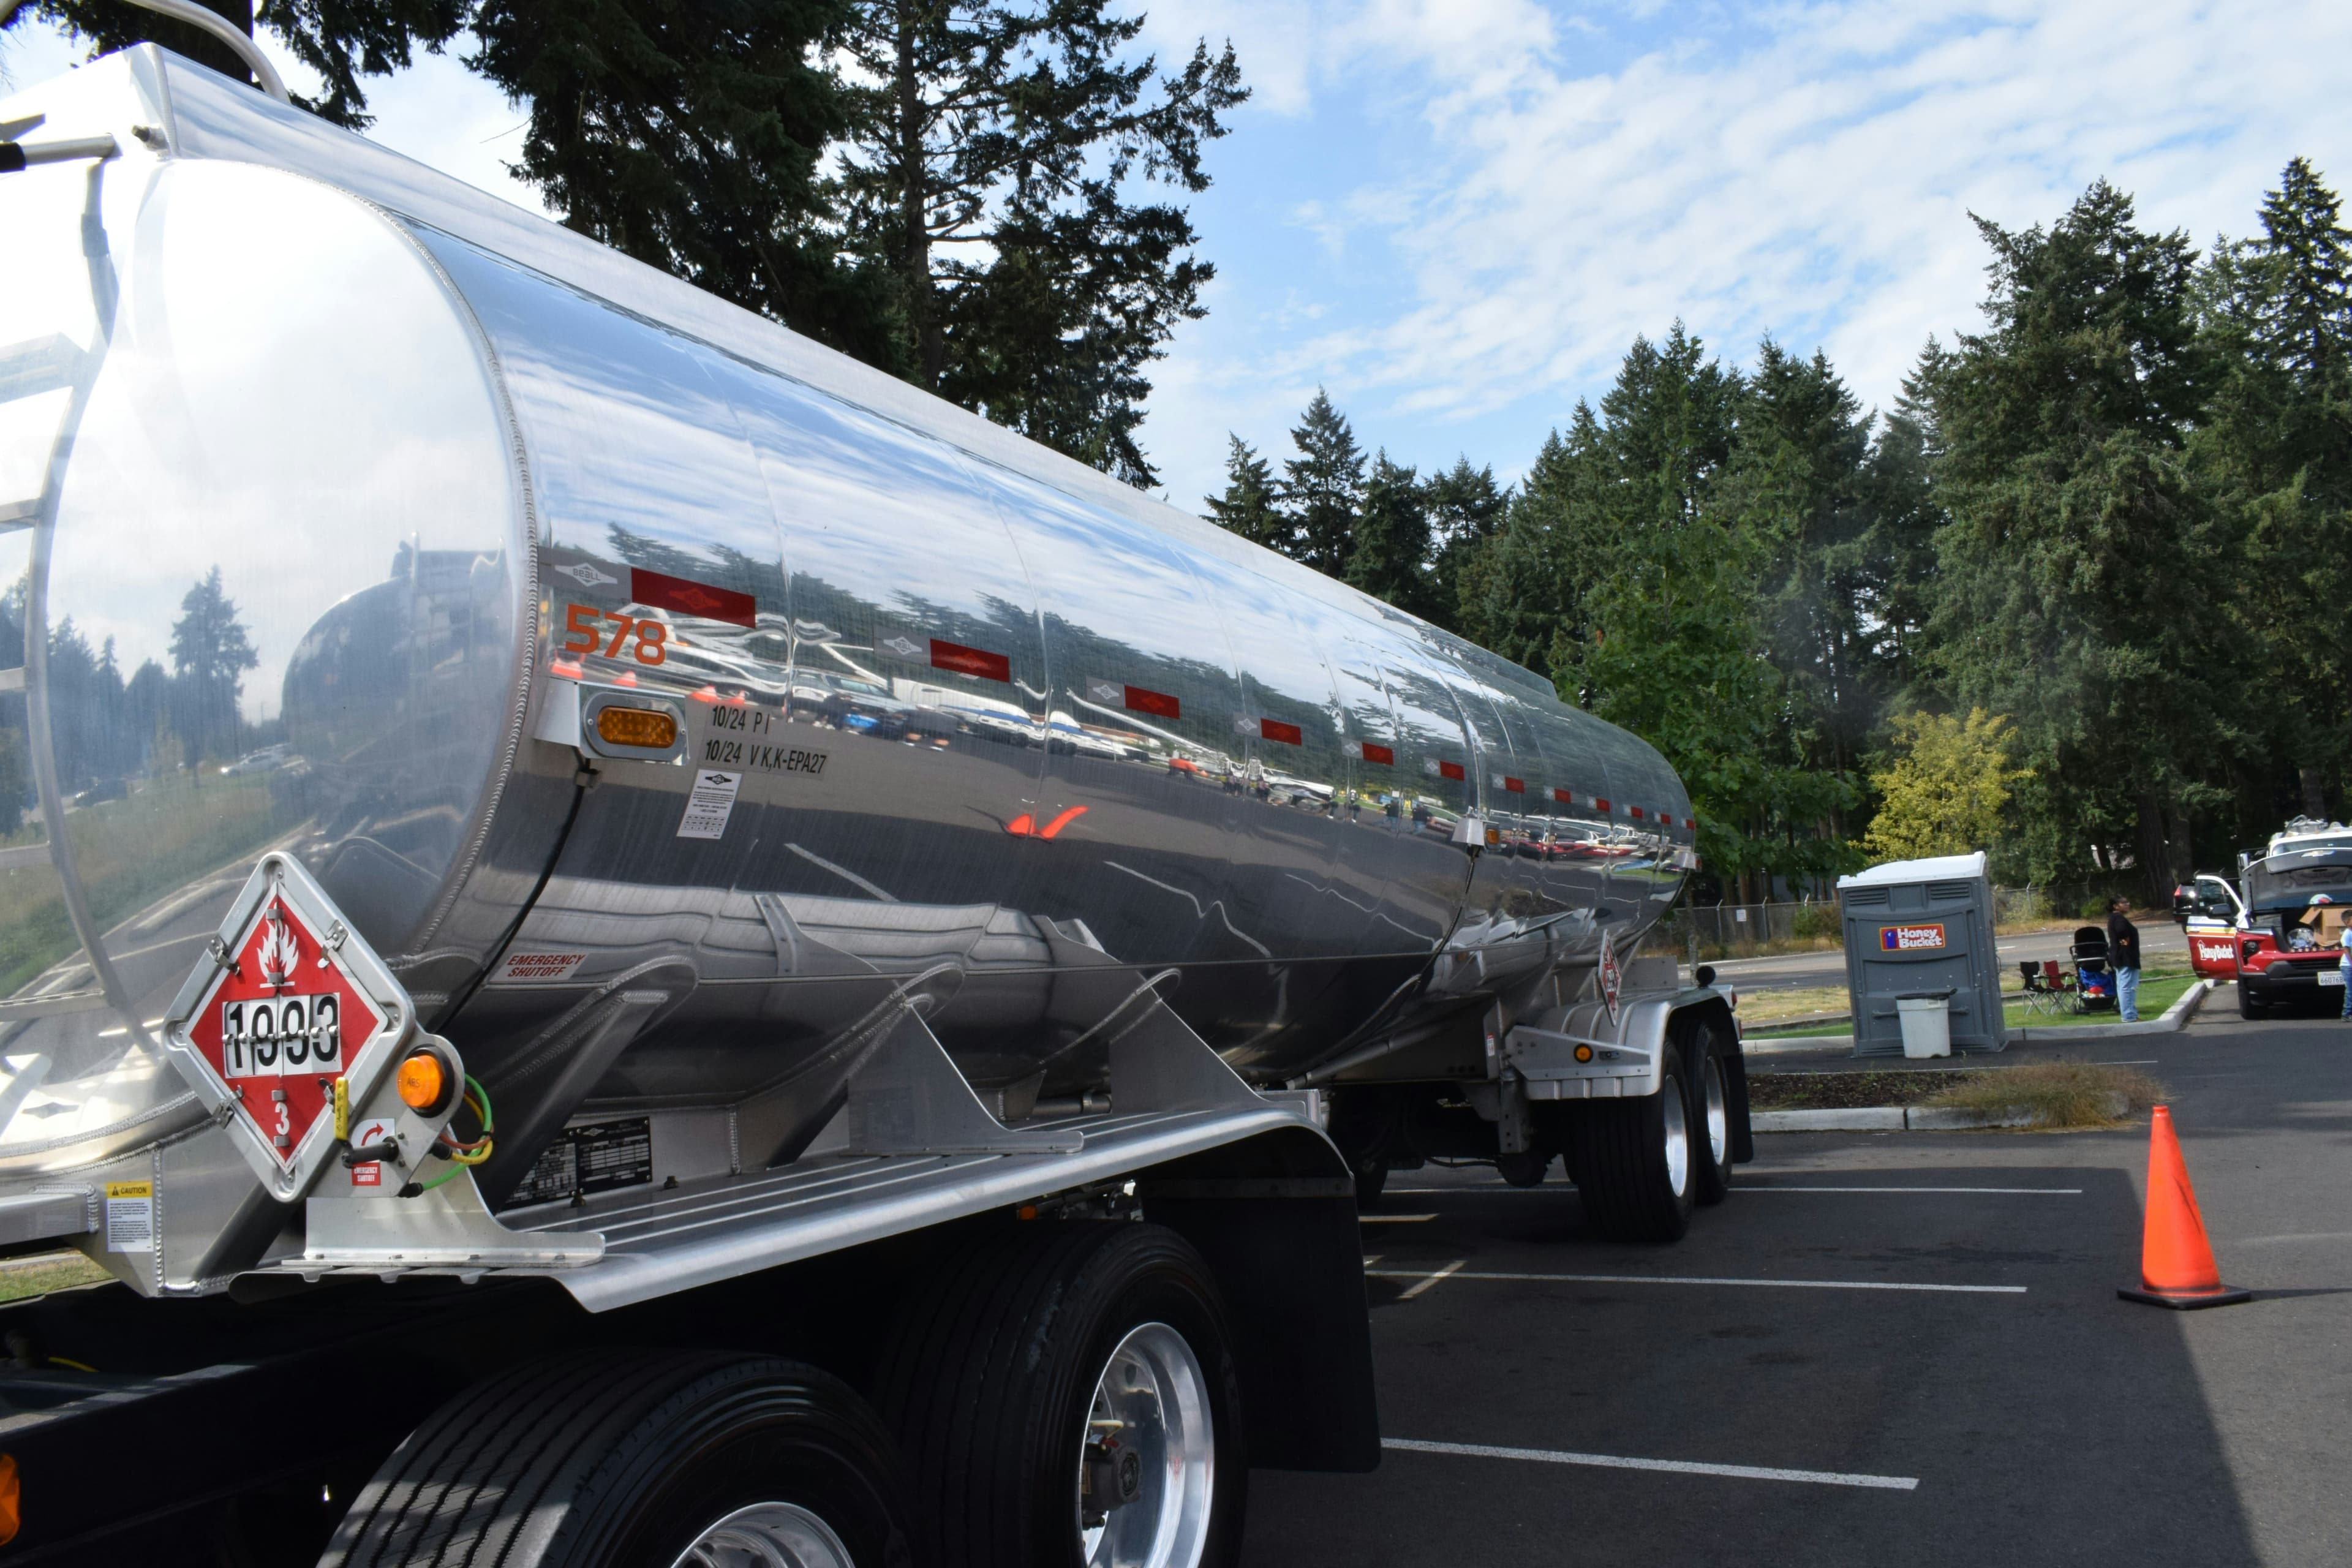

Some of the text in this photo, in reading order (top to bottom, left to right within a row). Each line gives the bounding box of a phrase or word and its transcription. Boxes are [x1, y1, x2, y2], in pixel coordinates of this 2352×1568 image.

[565, 603, 667, 666] 578
[712, 705, 746, 731] 10/24
[705, 739, 742, 764] 10/24
[1897, 928, 1937, 939] Honey
[1899, 935, 1942, 948] Bucket
[507, 954, 586, 966] EMERGENCY
[508, 967, 567, 978] SHUTOFF
[227, 995, 339, 1069] 1993
[407, 1077, 421, 1088] ABS
[275, 1102, 290, 1135] 3
